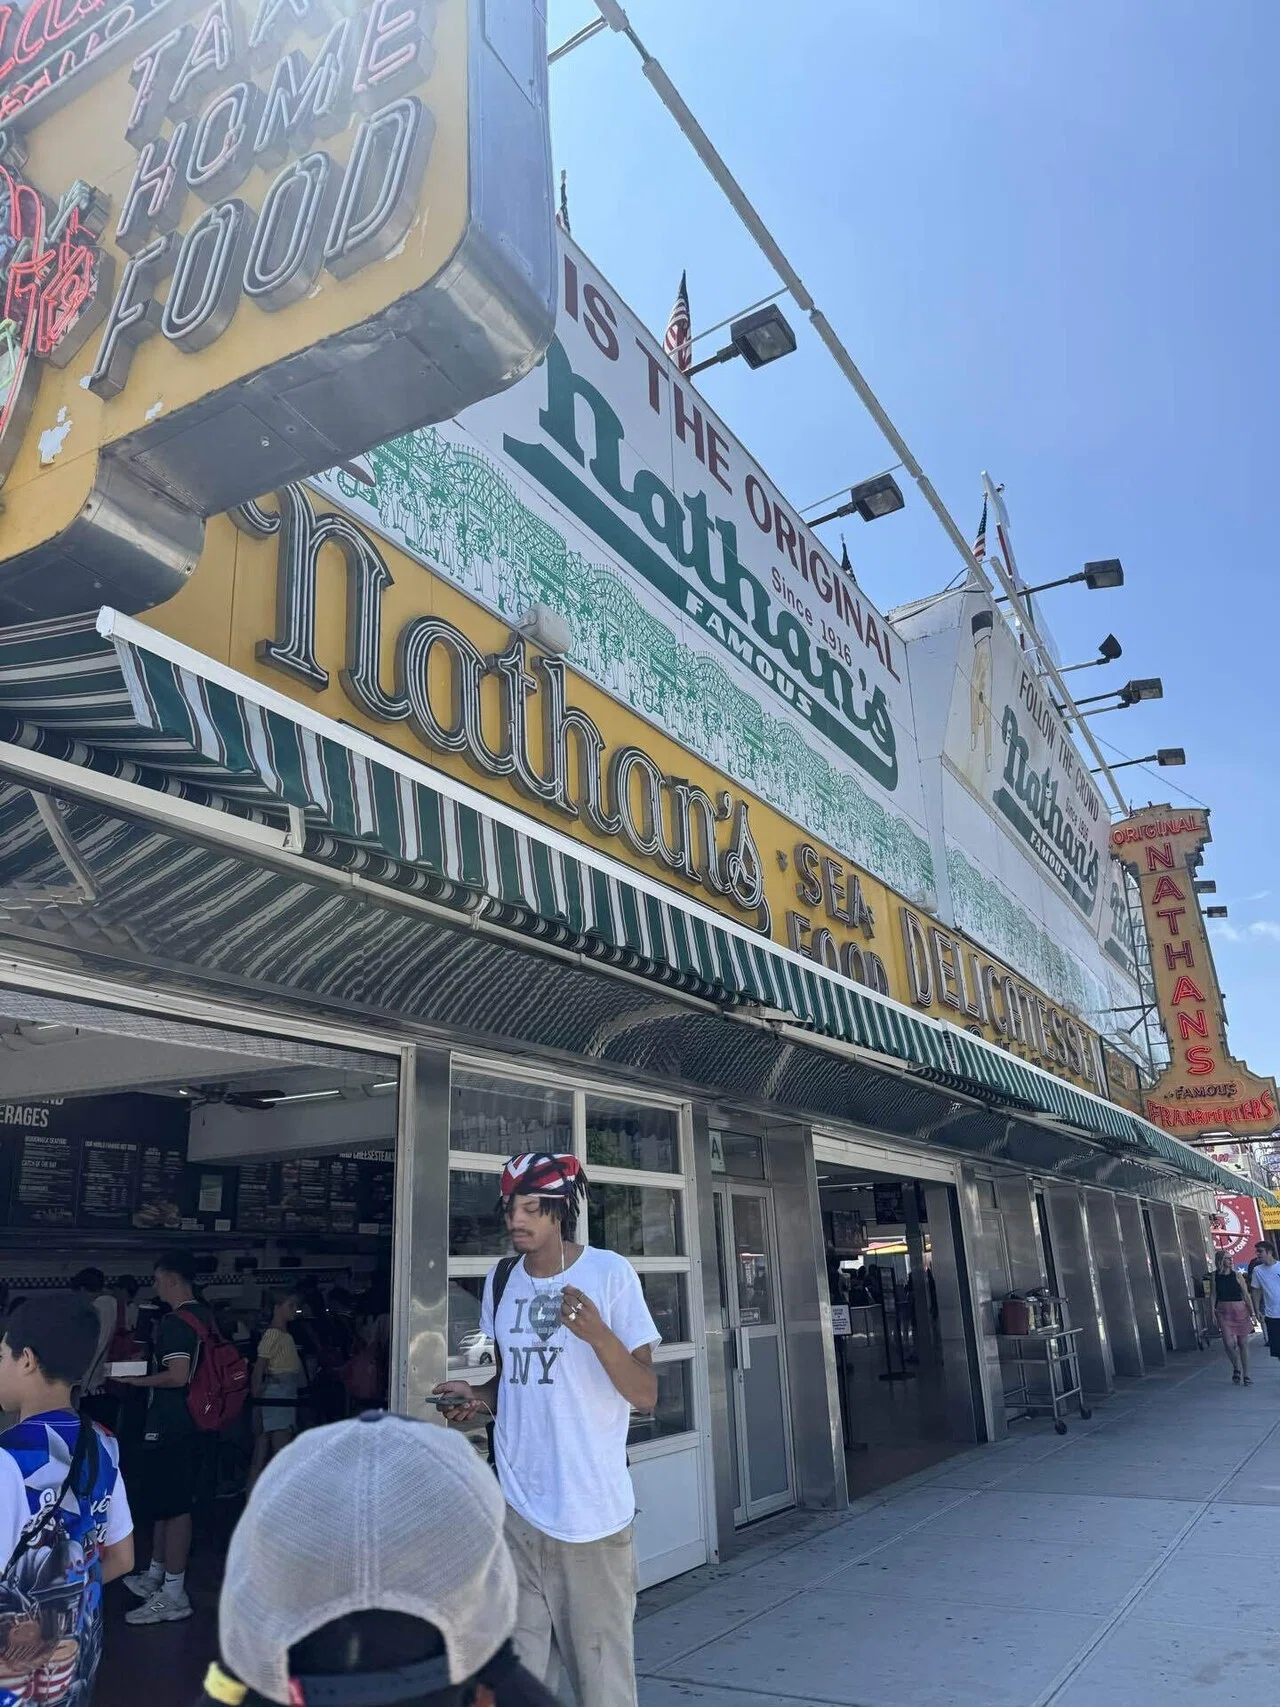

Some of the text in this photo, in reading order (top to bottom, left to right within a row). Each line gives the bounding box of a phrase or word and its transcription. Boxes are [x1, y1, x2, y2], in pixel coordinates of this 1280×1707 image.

[126, 0, 318, 135] TAK
[116, 0, 425, 242] HOME
[90, 95, 428, 395] FOOD
[563, 254, 901, 684] IS THE ORIGINAL
[684, 590, 816, 722] FAMOUS
[771, 566, 852, 667] Since 1916
[1018, 670, 1100, 823] FOLLOW THE CROWD
[1029, 828, 1068, 884] FAMOUS
[1111, 814, 1203, 845] ORIGINAL
[795, 843, 875, 938] SEA
[1146, 841, 1216, 1075] NATHANS
[1146, 1088, 1275, 1128] FRANKFURTERS
[1174, 1083, 1238, 1100] FAMOUS
[711, 1136, 721, 1160] A
[1234, 1225, 1251, 1252] CONTST
[508, 1298, 528, 1334] I
[508, 1346, 564, 1385] NY
